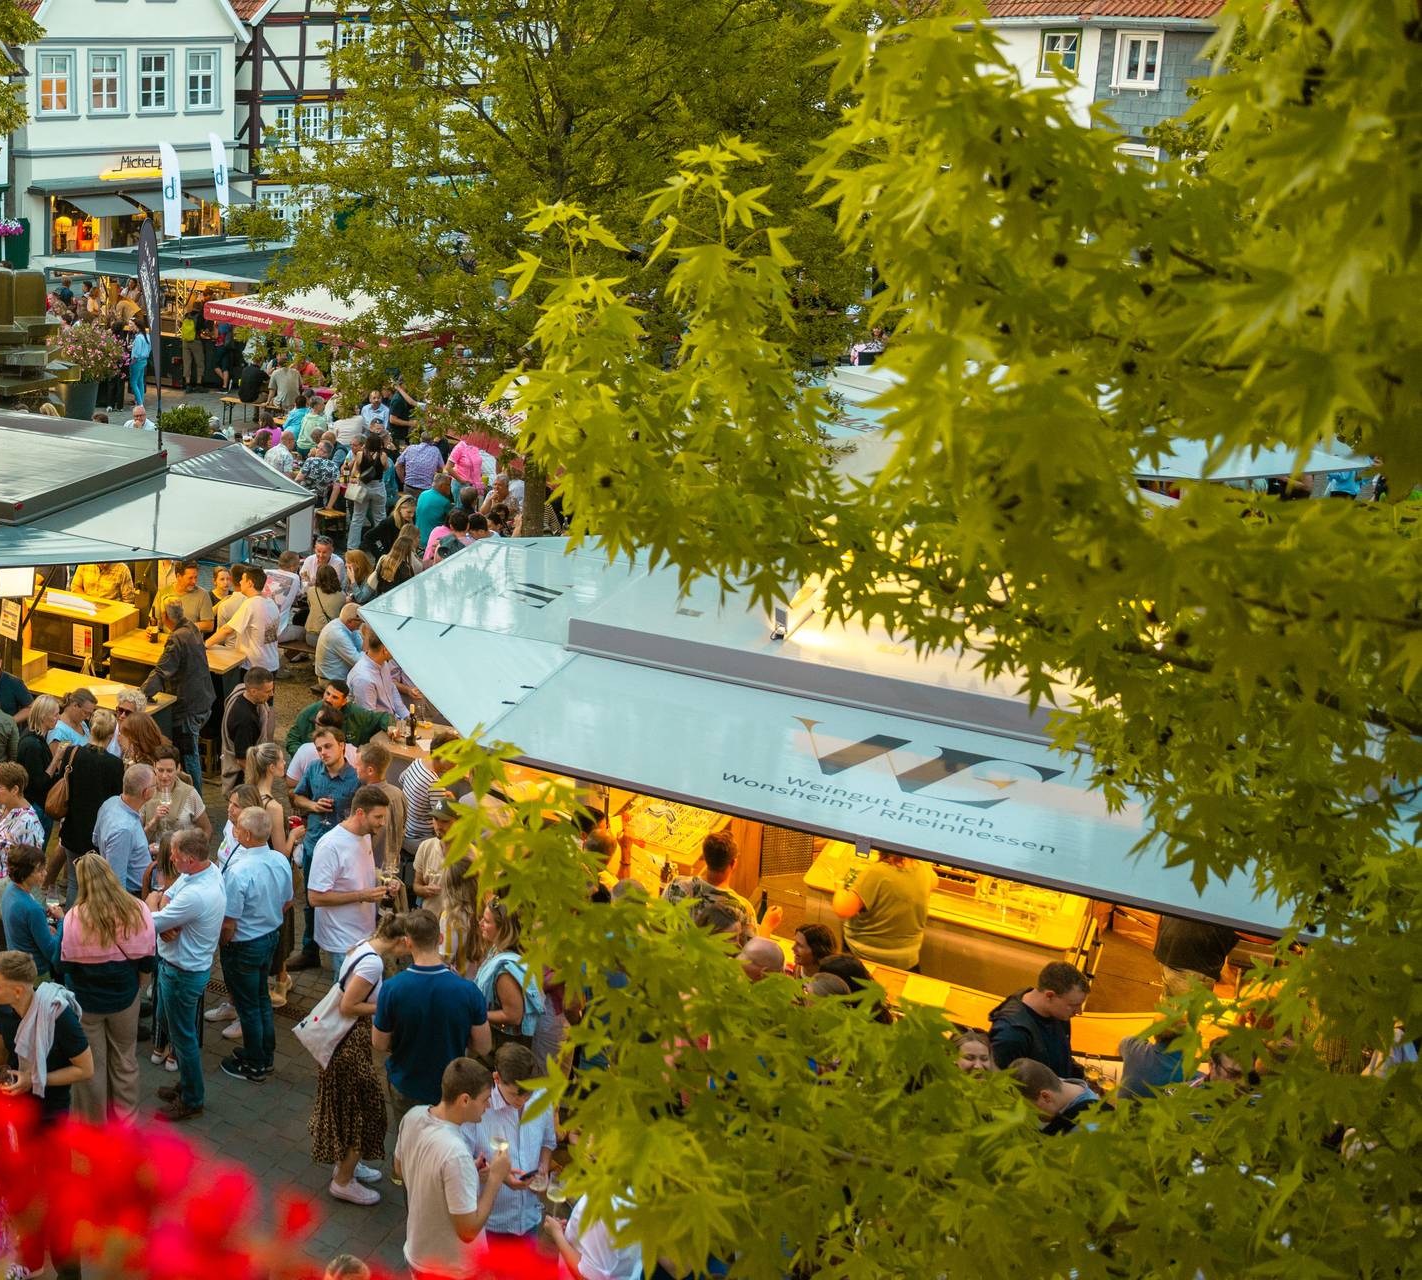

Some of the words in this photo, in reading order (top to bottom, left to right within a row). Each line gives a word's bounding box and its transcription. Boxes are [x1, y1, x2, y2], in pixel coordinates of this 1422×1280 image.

[209, 306, 273, 326] www.weinsommer.de
[722, 772, 854, 810] Wonsheim
[880, 809, 1056, 855] Rheinhessen
[787, 776, 894, 808] Weingut
[899, 802, 994, 829] Emrich
